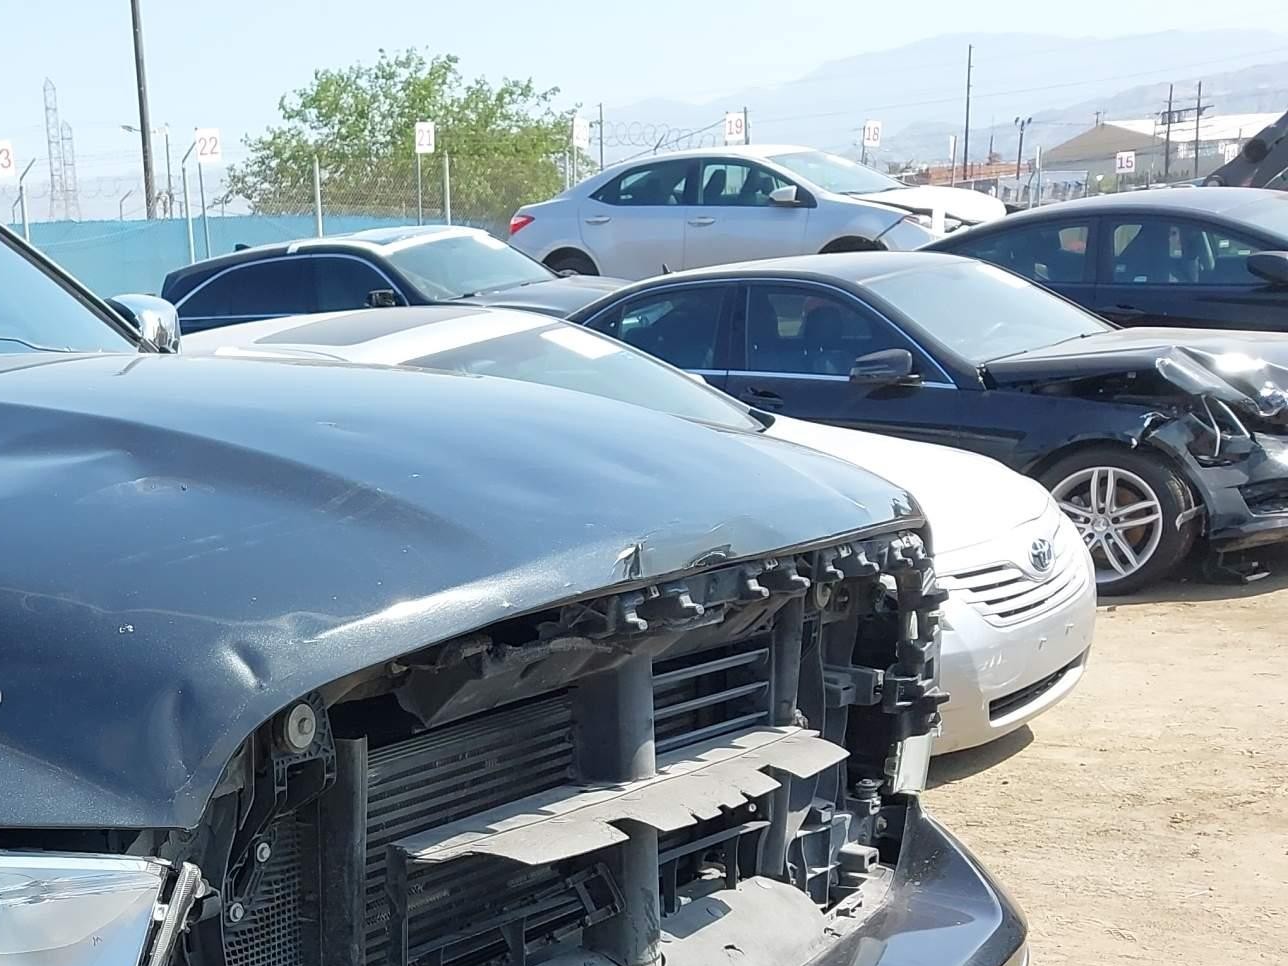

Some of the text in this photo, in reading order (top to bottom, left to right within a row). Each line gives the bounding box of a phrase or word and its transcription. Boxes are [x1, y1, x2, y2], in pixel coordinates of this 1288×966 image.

[727, 118, 743, 136] 19
[866, 126, 880, 142] 18
[198, 136, 219, 156] 22
[417, 128, 432, 147] 21
[1117, 154, 1134, 169] 15
